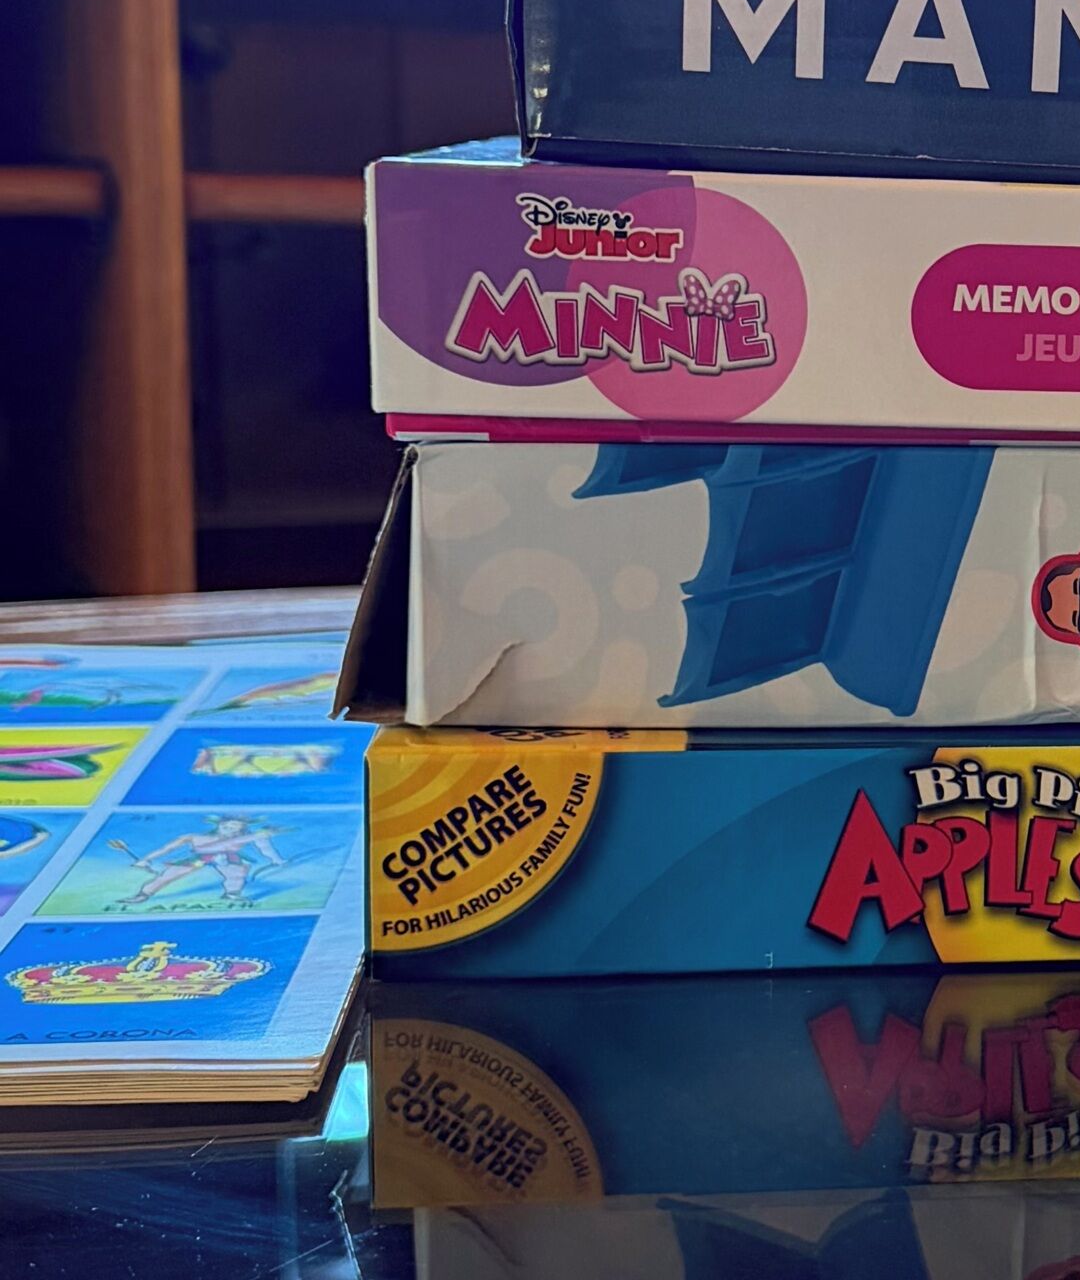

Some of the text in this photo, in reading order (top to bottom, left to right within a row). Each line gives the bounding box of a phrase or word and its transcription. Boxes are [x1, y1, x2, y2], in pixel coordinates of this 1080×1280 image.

[451, 274, 773, 369] MINNIE
[381, 764, 533, 881] COMPARE
[909, 762, 1022, 810] Big
[381, 772, 592, 936] FOR HILARIOUS FAMILY FUN!
[397, 789, 548, 906] PICTURES
[45, 1028, 199, 1041] CORONA
